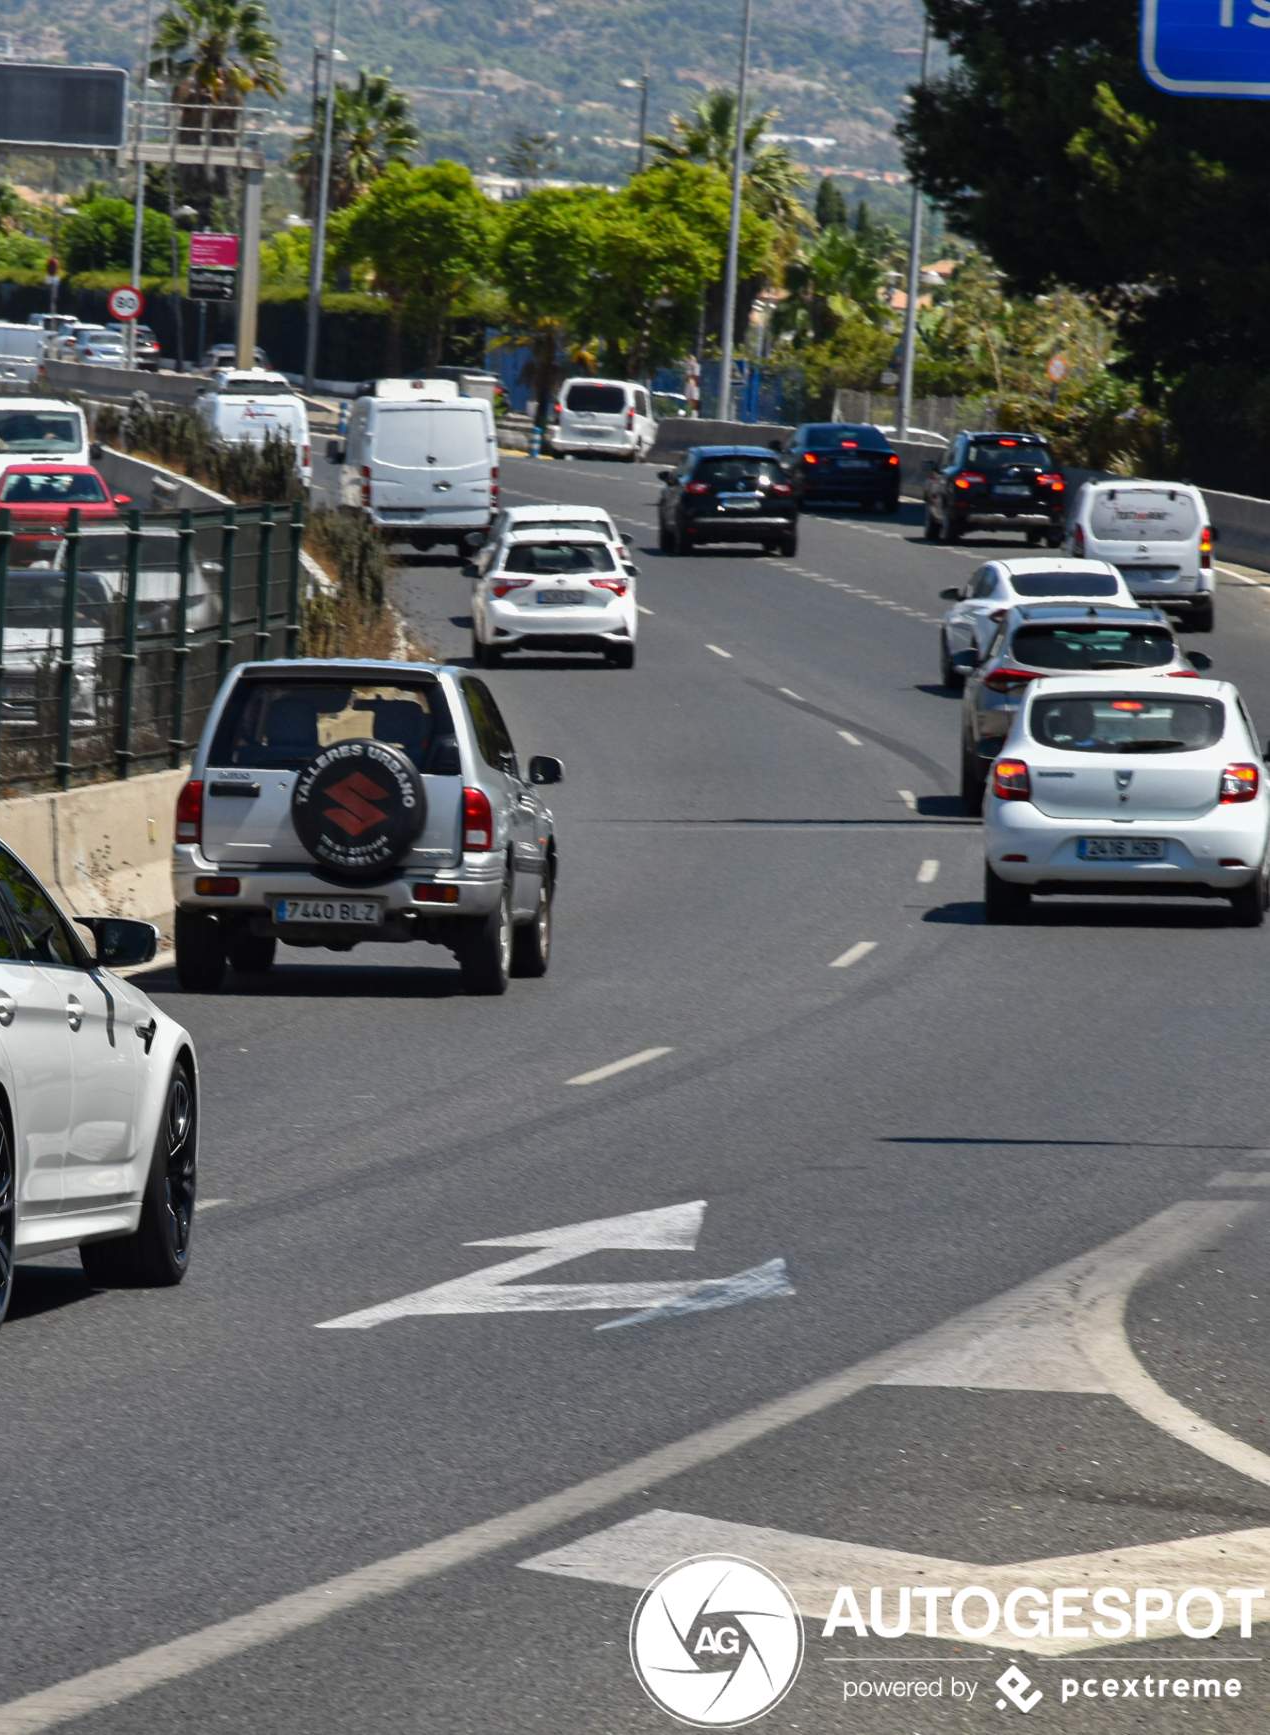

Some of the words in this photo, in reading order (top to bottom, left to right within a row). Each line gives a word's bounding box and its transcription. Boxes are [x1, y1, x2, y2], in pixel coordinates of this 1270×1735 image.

[295, 744, 364, 805] TALLERES
[367, 746, 416, 808] URBANO
[288, 902, 335, 919] 7440
[340, 903, 375, 921] BLZ
